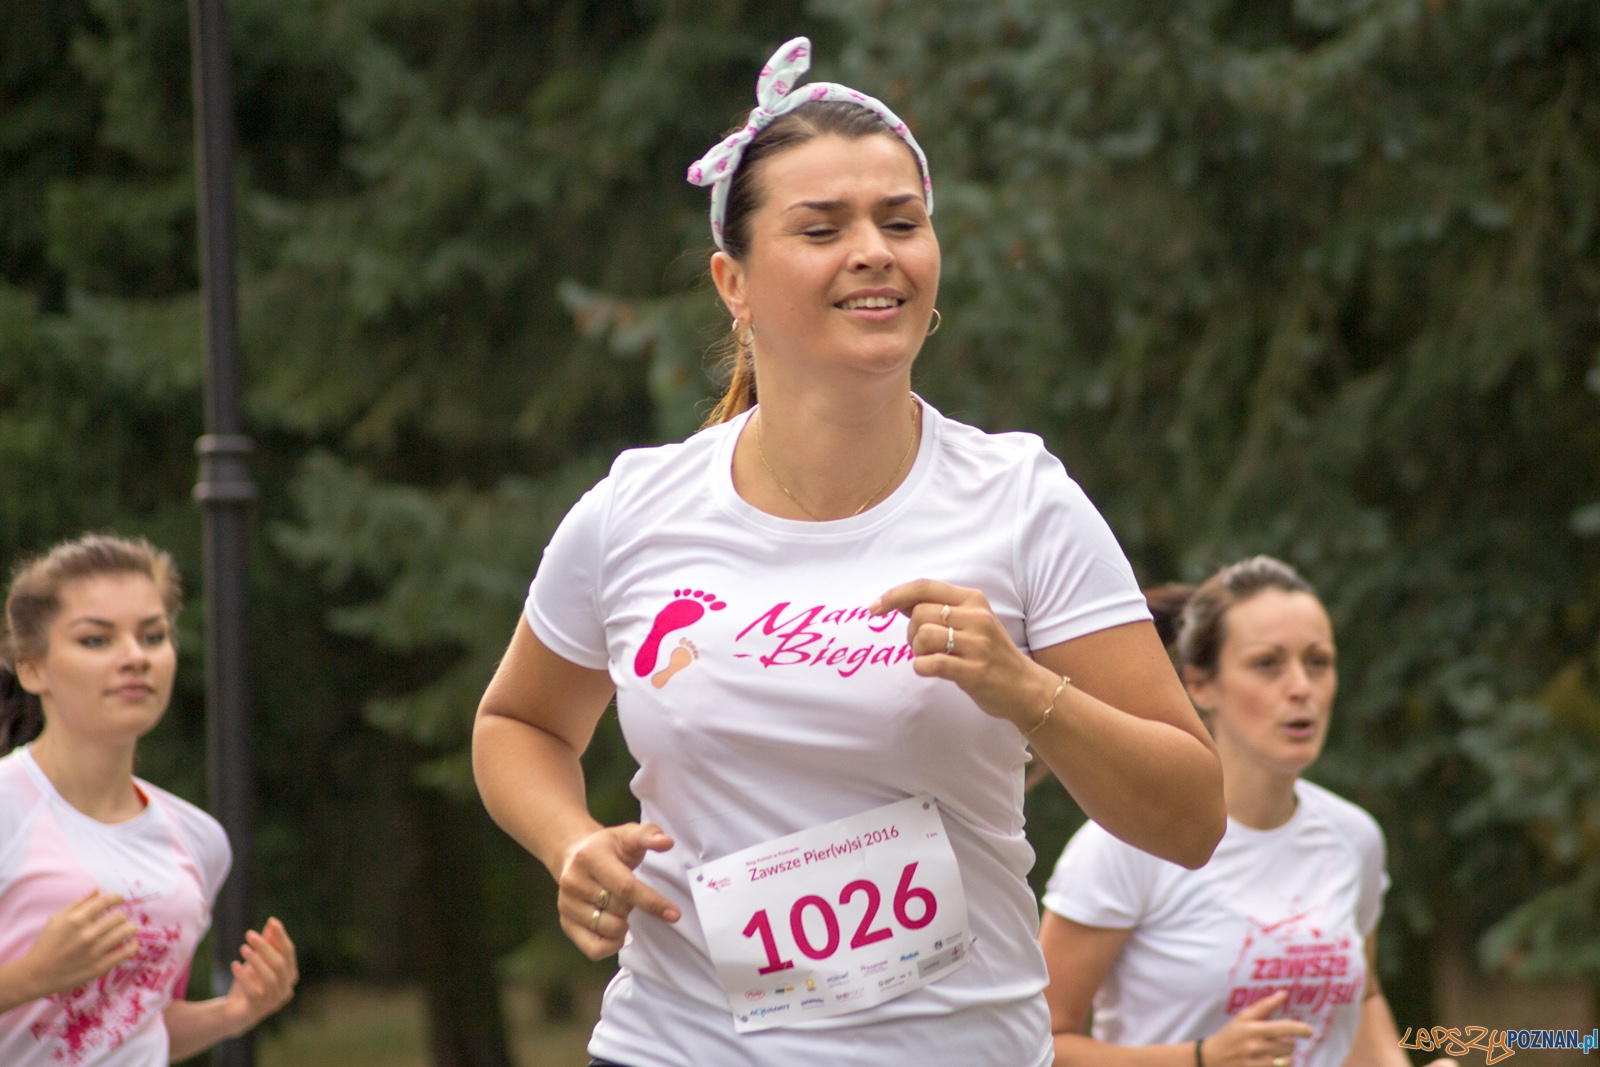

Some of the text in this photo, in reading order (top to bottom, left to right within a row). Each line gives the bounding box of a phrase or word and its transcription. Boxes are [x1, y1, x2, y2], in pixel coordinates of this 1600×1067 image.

[748, 824, 899, 882] Zawsze Pier(w)si 2016
[742, 861, 938, 977] 1026
[1252, 955, 1349, 981] zawsze
